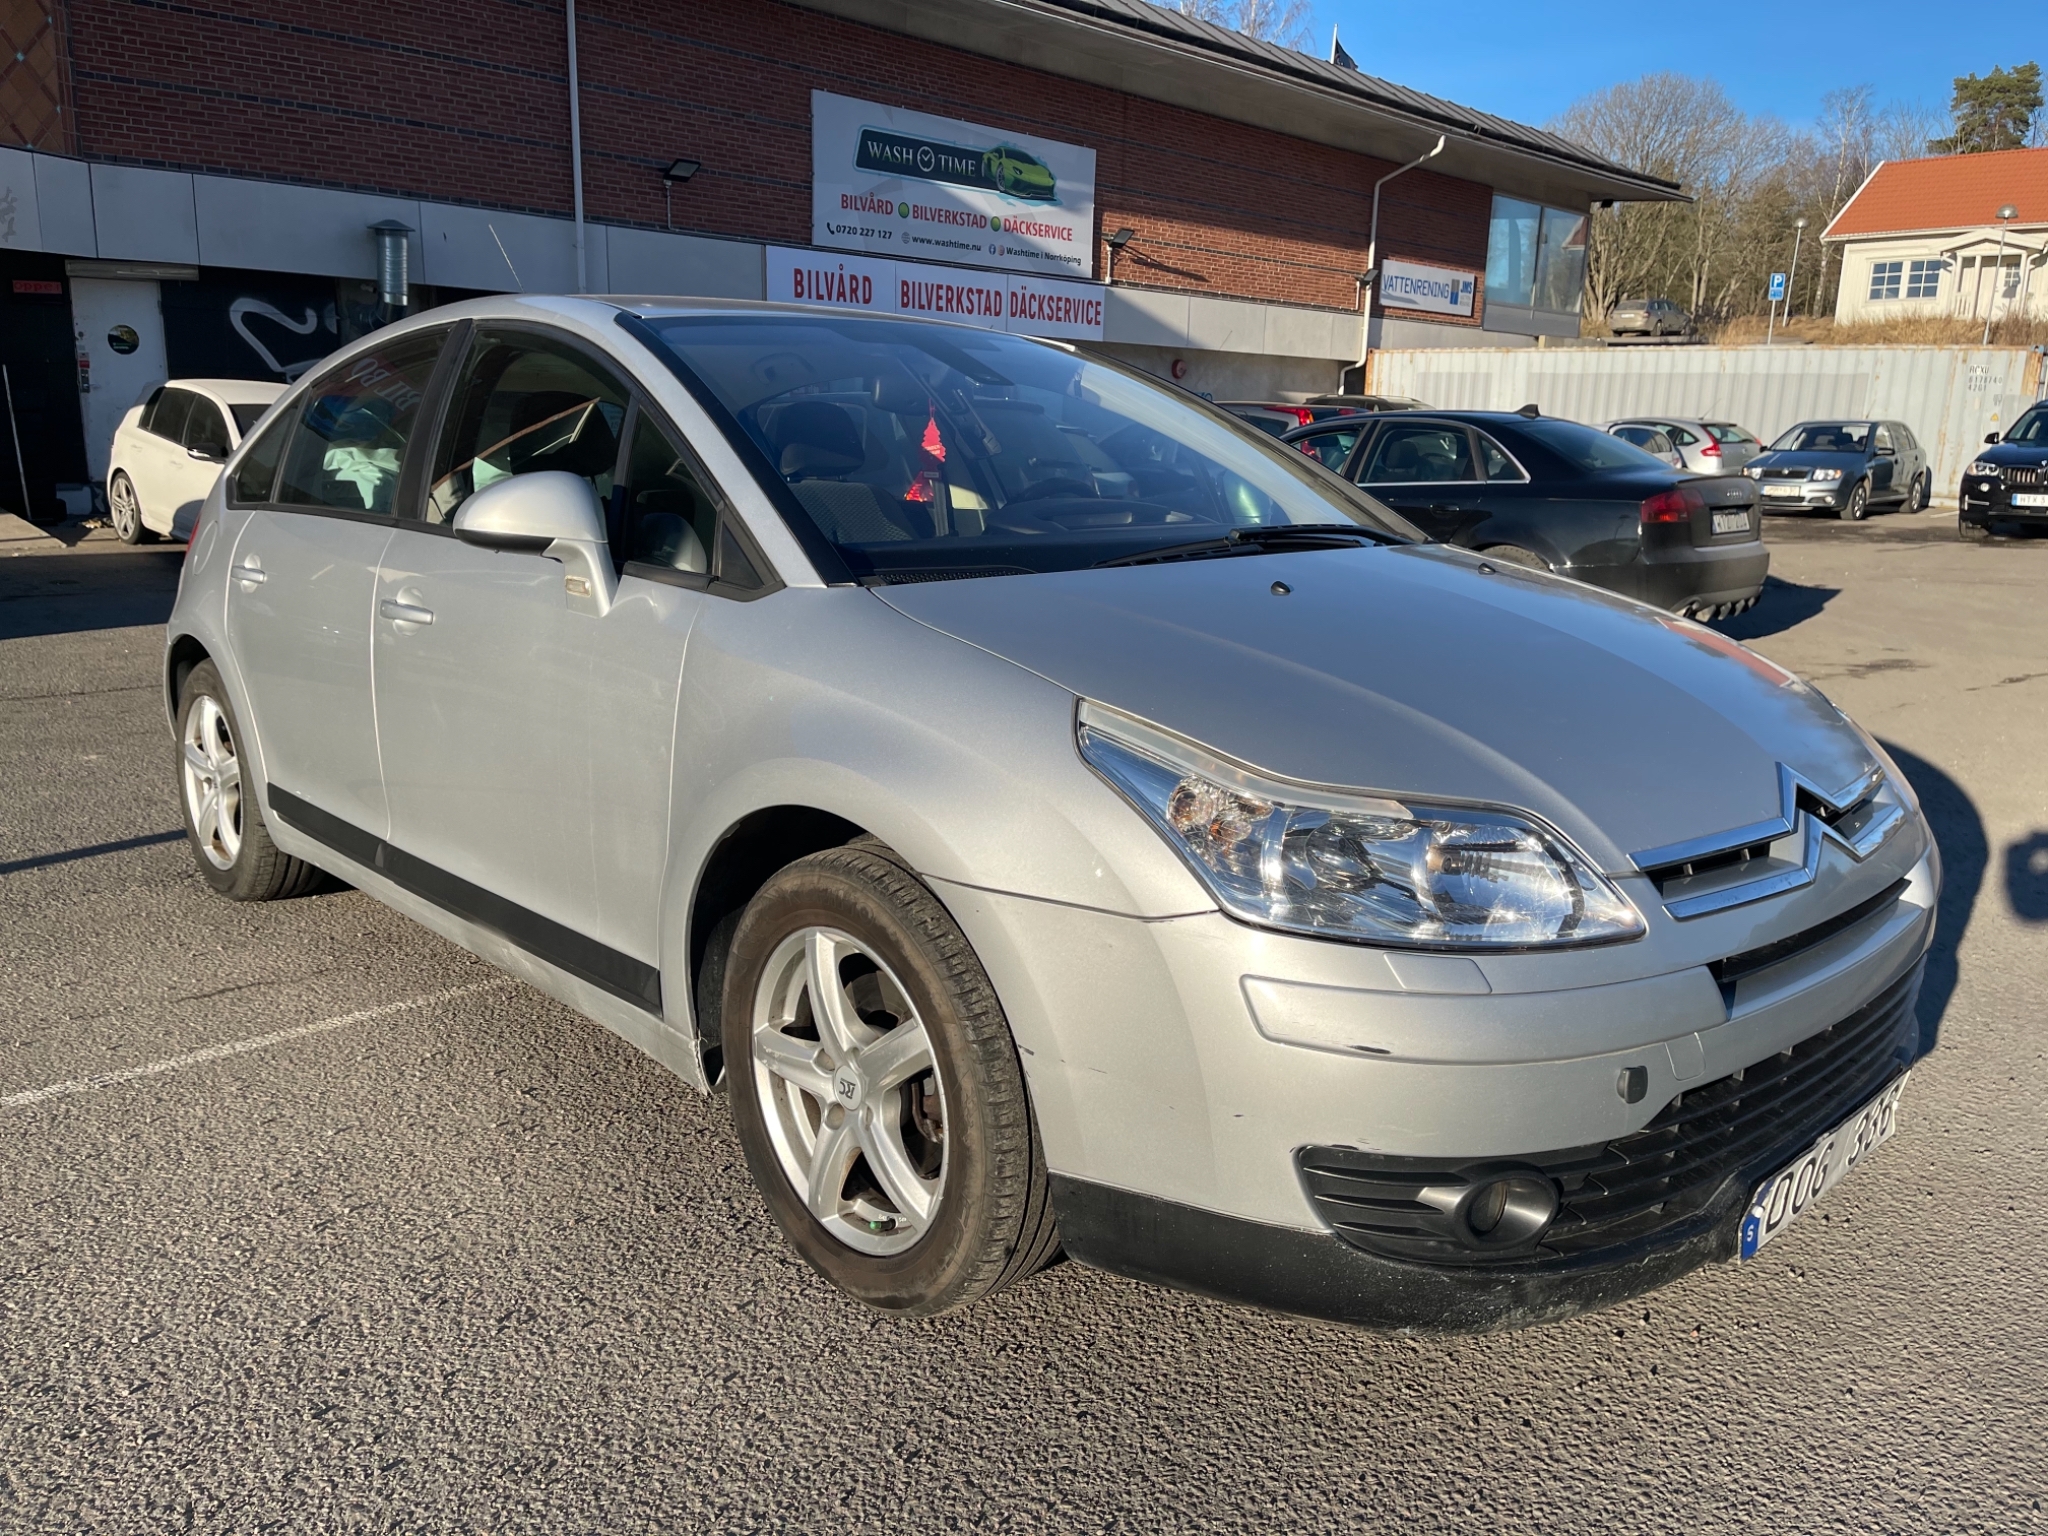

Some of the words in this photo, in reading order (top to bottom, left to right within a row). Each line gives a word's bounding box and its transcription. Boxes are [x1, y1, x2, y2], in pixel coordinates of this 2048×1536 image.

[867, 140, 913, 166] WASH
[938, 154, 976, 177] TIME
[841, 192, 893, 215] BILVÅRD
[912, 204, 987, 229] BILVERKSTAD
[1003, 215, 1073, 242] DÄCKSERVICE
[835, 224, 857, 236] 0720
[859, 227, 875, 238] 227
[877, 229, 893, 240] 127
[912, 235, 982, 252] www.washtime.nu
[1006, 246, 1039, 260] Washtime
[1044, 251, 1082, 267] Norrköping
[1383, 273, 1450, 299] VATTENRENING
[1773, 275, 1783, 287] P
[794, 263, 872, 305] BILVÅRD
[901, 279, 1003, 317] BILVERKSTAD
[1010, 286, 1102, 326] DÄCKSERVICE
[1746, 1224, 1755, 1242] S
[1765, 1141, 1834, 1234] DOG
[1846, 1084, 1900, 1166] 336
